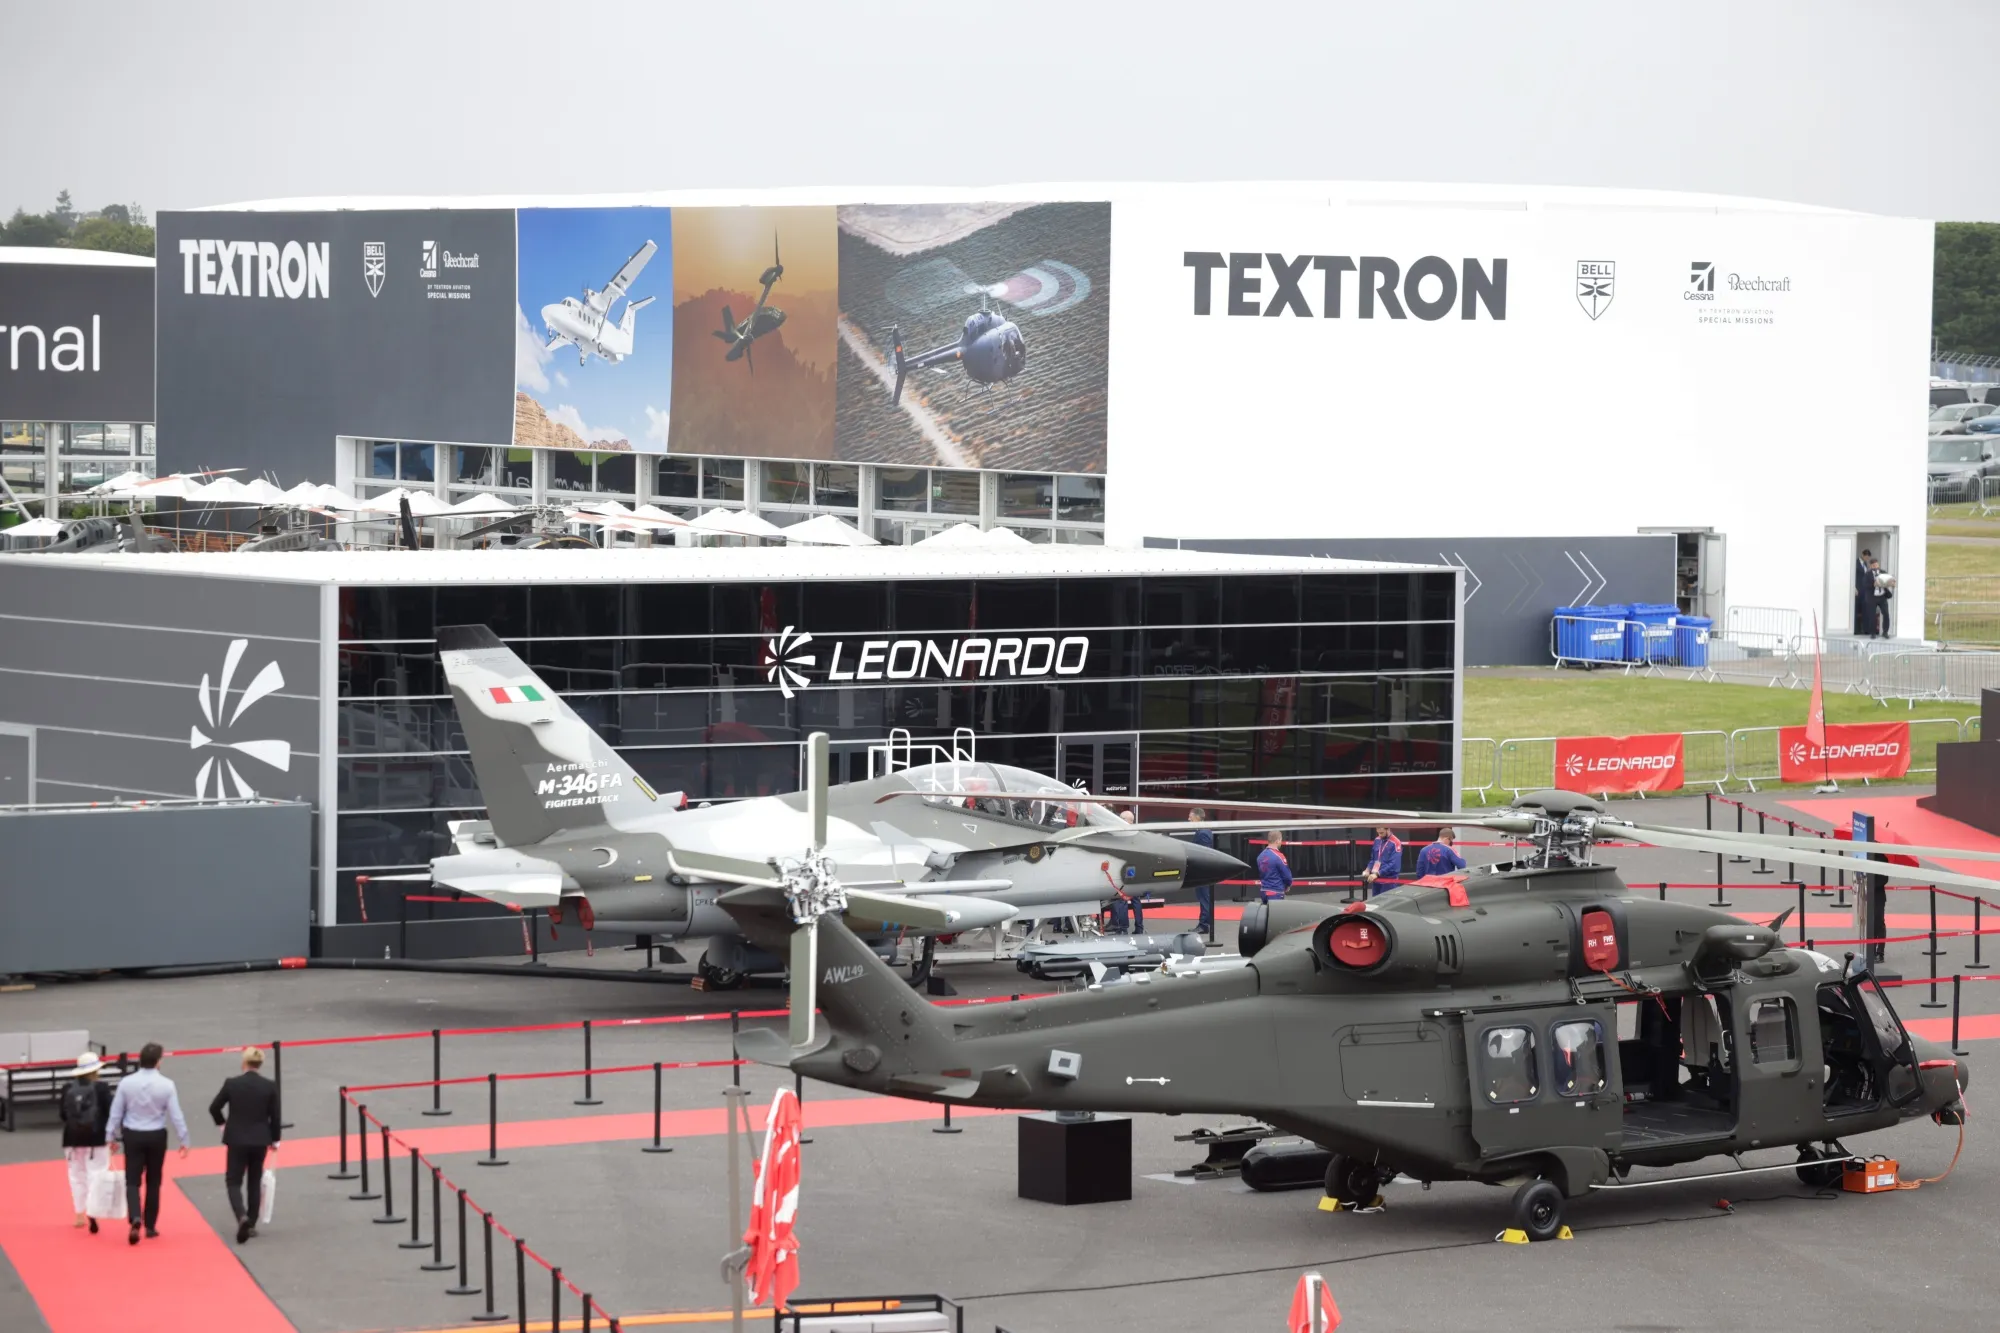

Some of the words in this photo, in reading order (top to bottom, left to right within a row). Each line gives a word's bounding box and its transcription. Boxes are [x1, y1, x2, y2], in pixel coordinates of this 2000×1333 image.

[366, 245, 383, 257] BELL
[443, 250, 480, 268] Beechcraft
[179, 239, 330, 299] TEXTRON
[420, 268, 437, 278] Cessna
[1581, 264, 1611, 275] BELL
[1183, 251, 1508, 321] TEXTRON
[1727, 273, 1792, 292] Beechcraft
[1683, 290, 1715, 301] Cessna
[1698, 316, 1732, 324] SPECIAL
[1735, 316, 1774, 324] MISSIONS
[828, 636, 1090, 681] LEONARDO
[1810, 742, 1900, 760] LEONARDO
[546, 759, 608, 773] Aermacchi
[1587, 755, 1676, 771] LEONARDO
[537, 772, 599, 796] M-346
[600, 772, 623, 788] FA
[544, 798, 584, 809] FIGHTER
[585, 794, 619, 805] ATTACK
[1360, 928, 1368, 939] RH
[1588, 939, 1597, 948] RH
[1603, 935, 1614, 944] FWD
[823, 964, 864, 984] AW149
